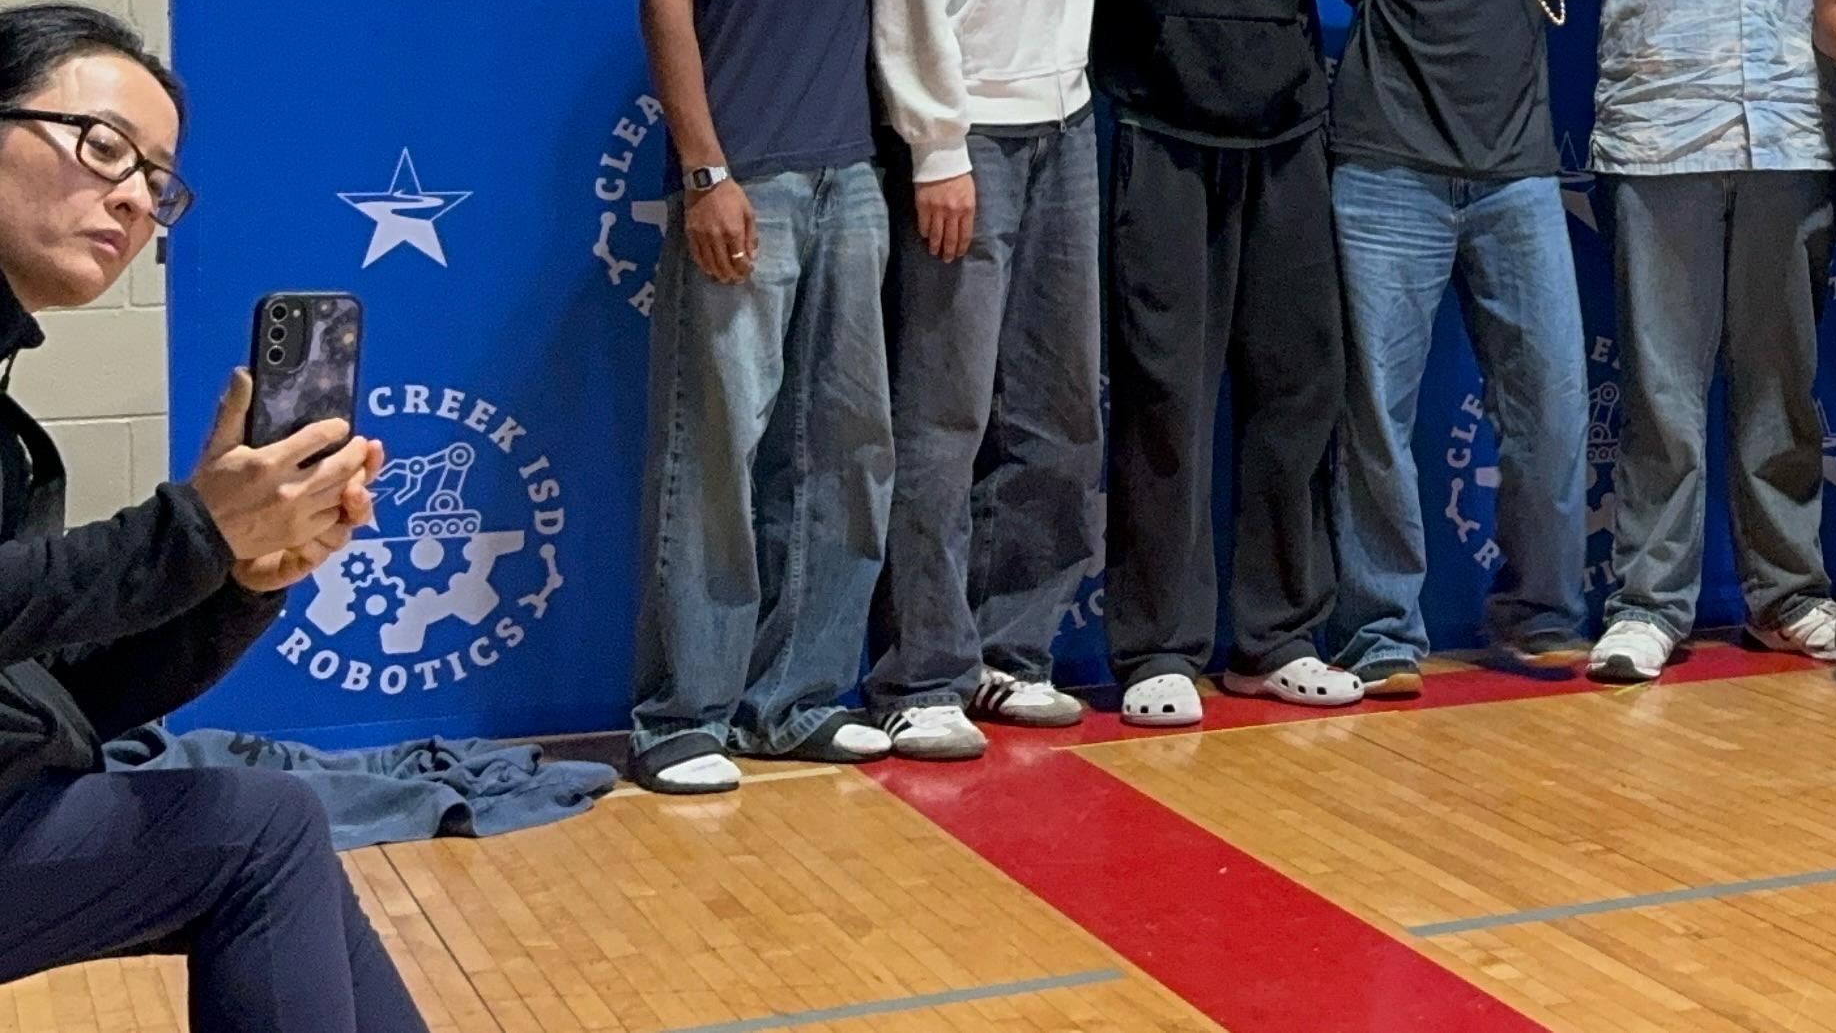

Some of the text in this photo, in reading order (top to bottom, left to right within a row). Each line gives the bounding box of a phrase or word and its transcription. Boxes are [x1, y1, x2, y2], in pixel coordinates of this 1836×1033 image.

[595, 94, 664, 201] CLEA
[368, 383, 565, 536] CREEK ISD
[276, 617, 525, 695] ROBOTICS
